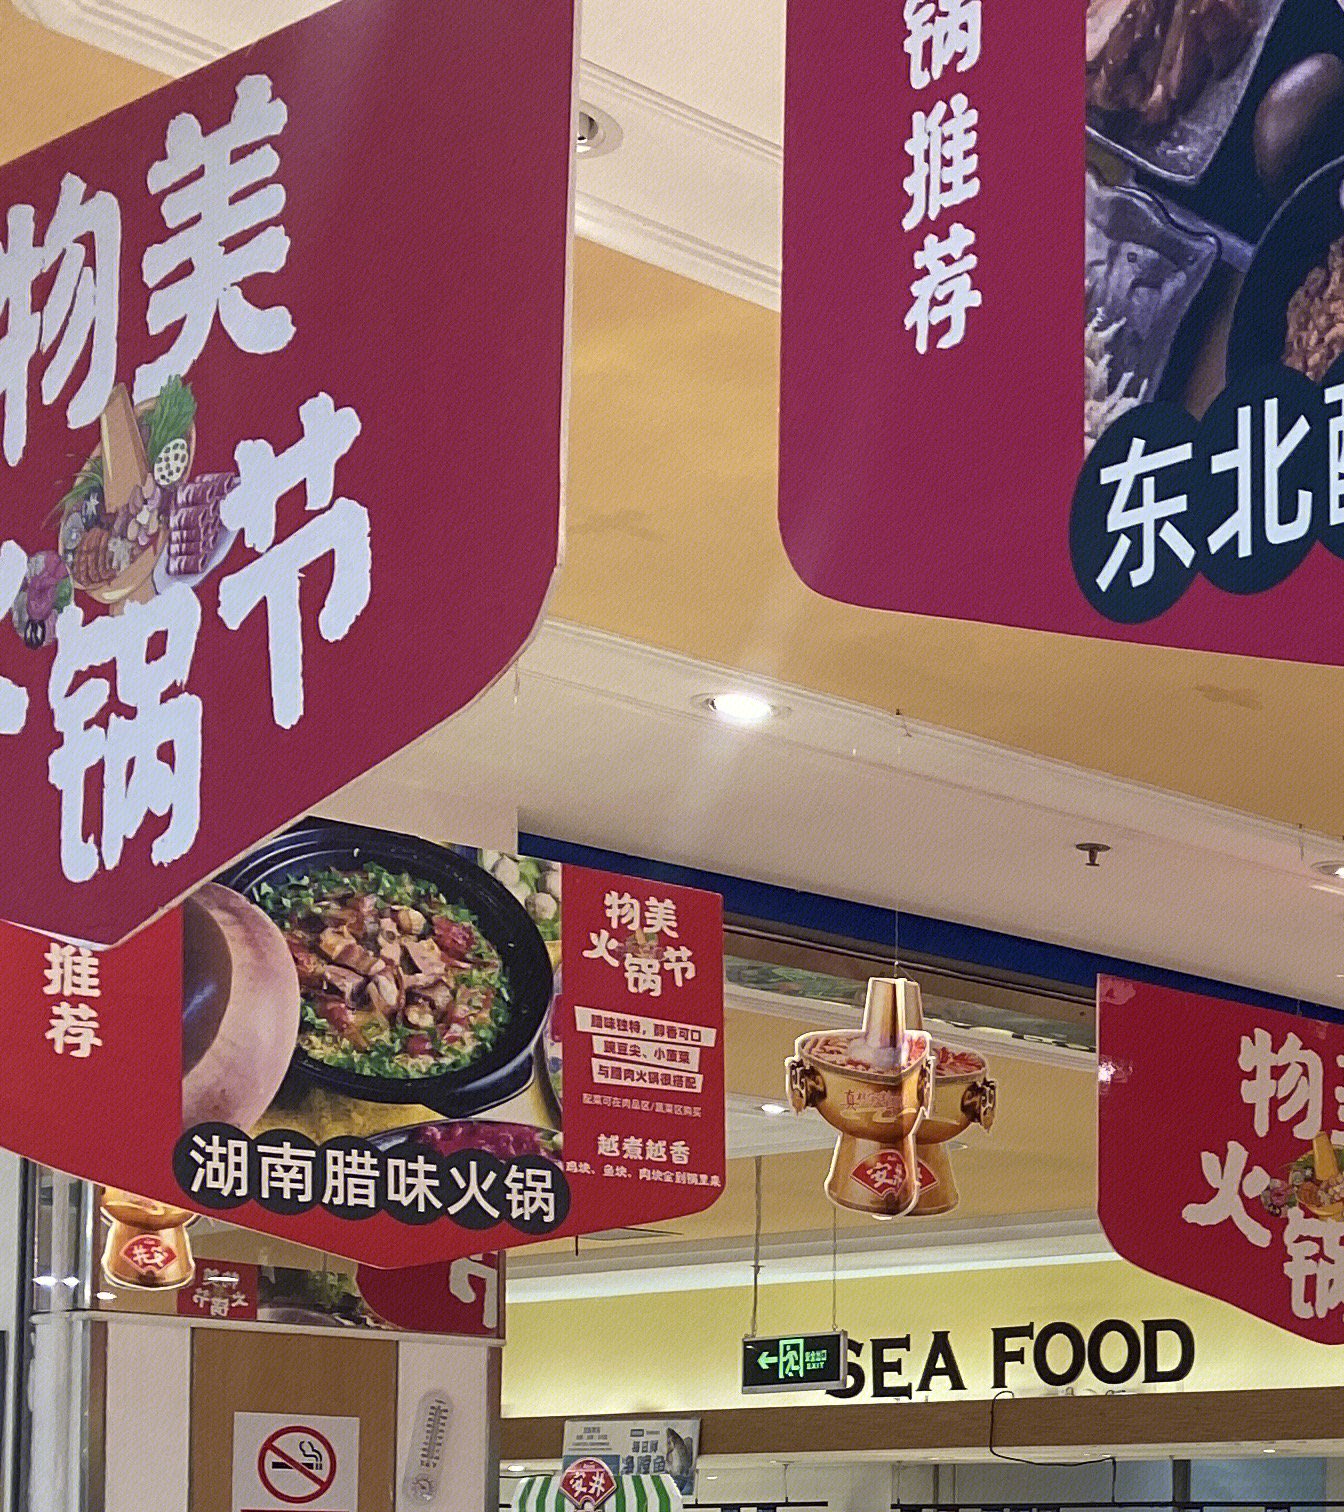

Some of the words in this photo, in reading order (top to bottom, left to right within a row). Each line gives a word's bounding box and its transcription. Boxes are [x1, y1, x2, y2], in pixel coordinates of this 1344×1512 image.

[0, 73, 297, 468] 物美
[0, 391, 372, 882] 锅节
[604, 890, 679, 938] 物美
[44, 943, 103, 1058] 推荐
[582, 929, 696, 997] 火锅节
[189, 1135, 556, 1223] 湖南腊味火锅
[597, 1133, 691, 1164] 越煮越香
[990, 1318, 1196, 1391] FOOD
